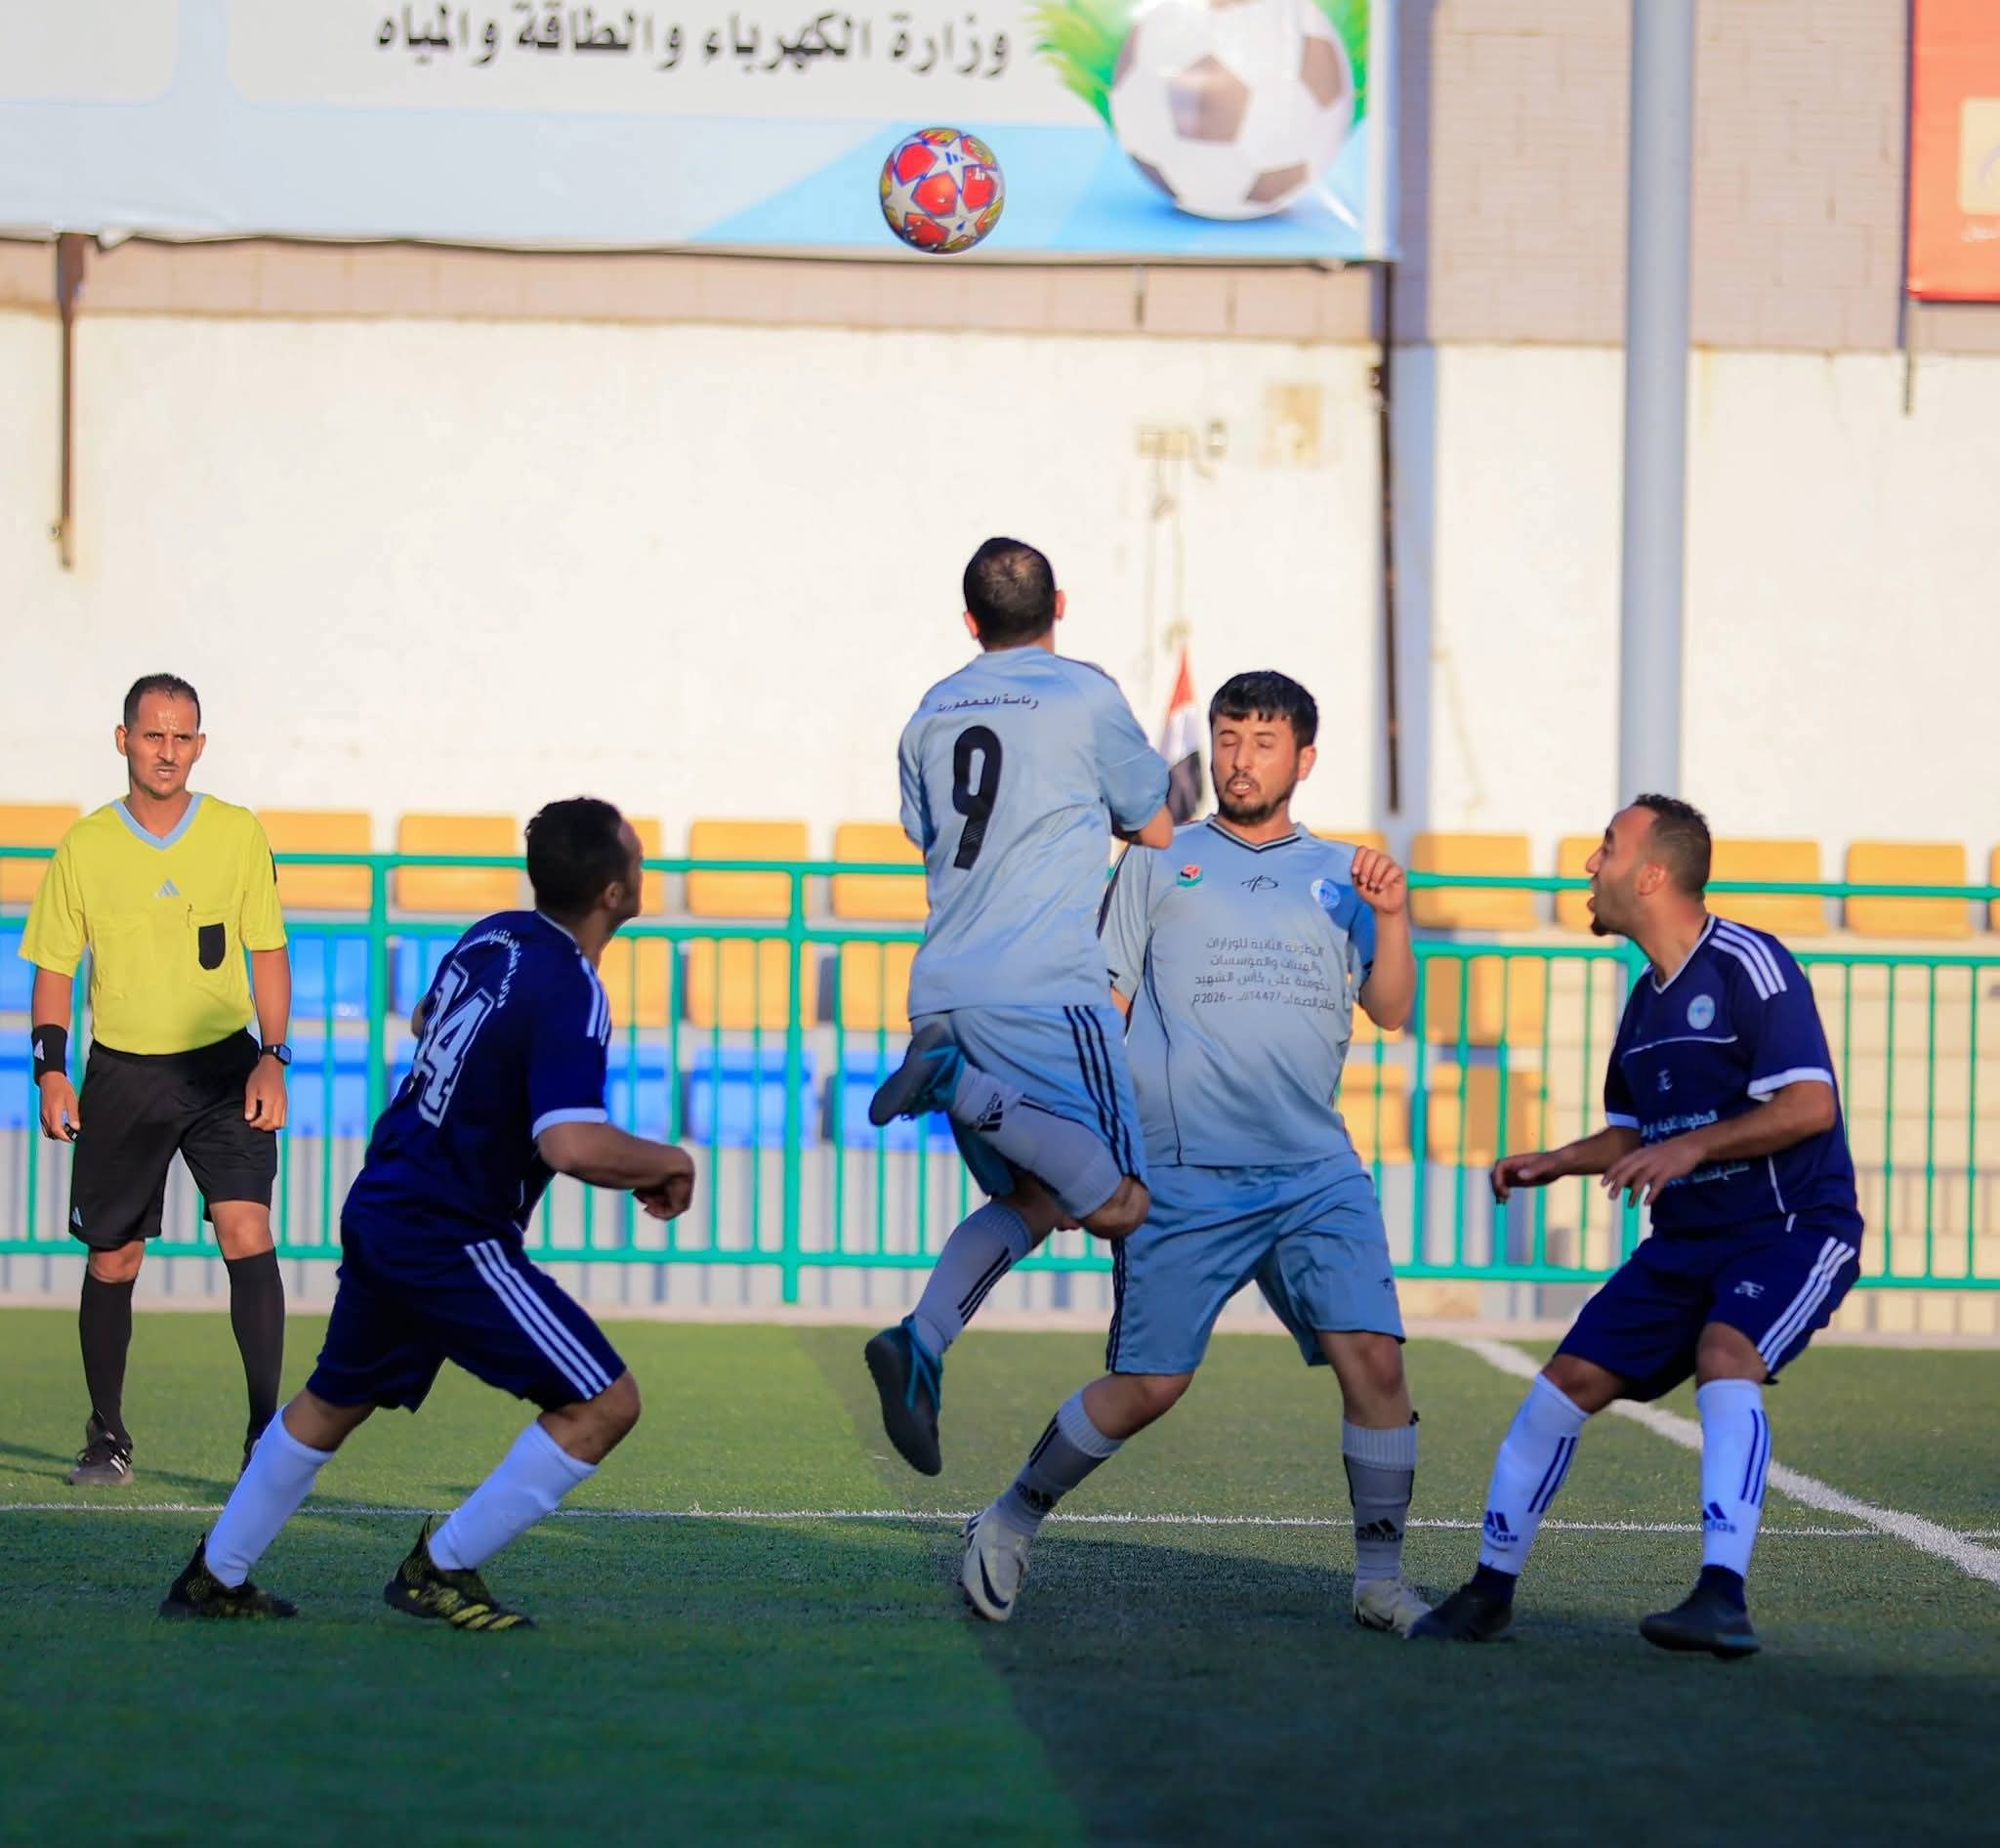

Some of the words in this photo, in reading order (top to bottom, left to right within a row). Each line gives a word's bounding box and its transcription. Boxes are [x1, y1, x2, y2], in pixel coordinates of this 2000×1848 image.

[377, 2, 497, 66] والمياه
[512, 1, 681, 69] والطاقة
[704, 13, 873, 72] الكهرباء
[890, 12, 1008, 77] وزارة
[952, 725, 1002, 871] 9
[412, 959, 495, 1128] 14
